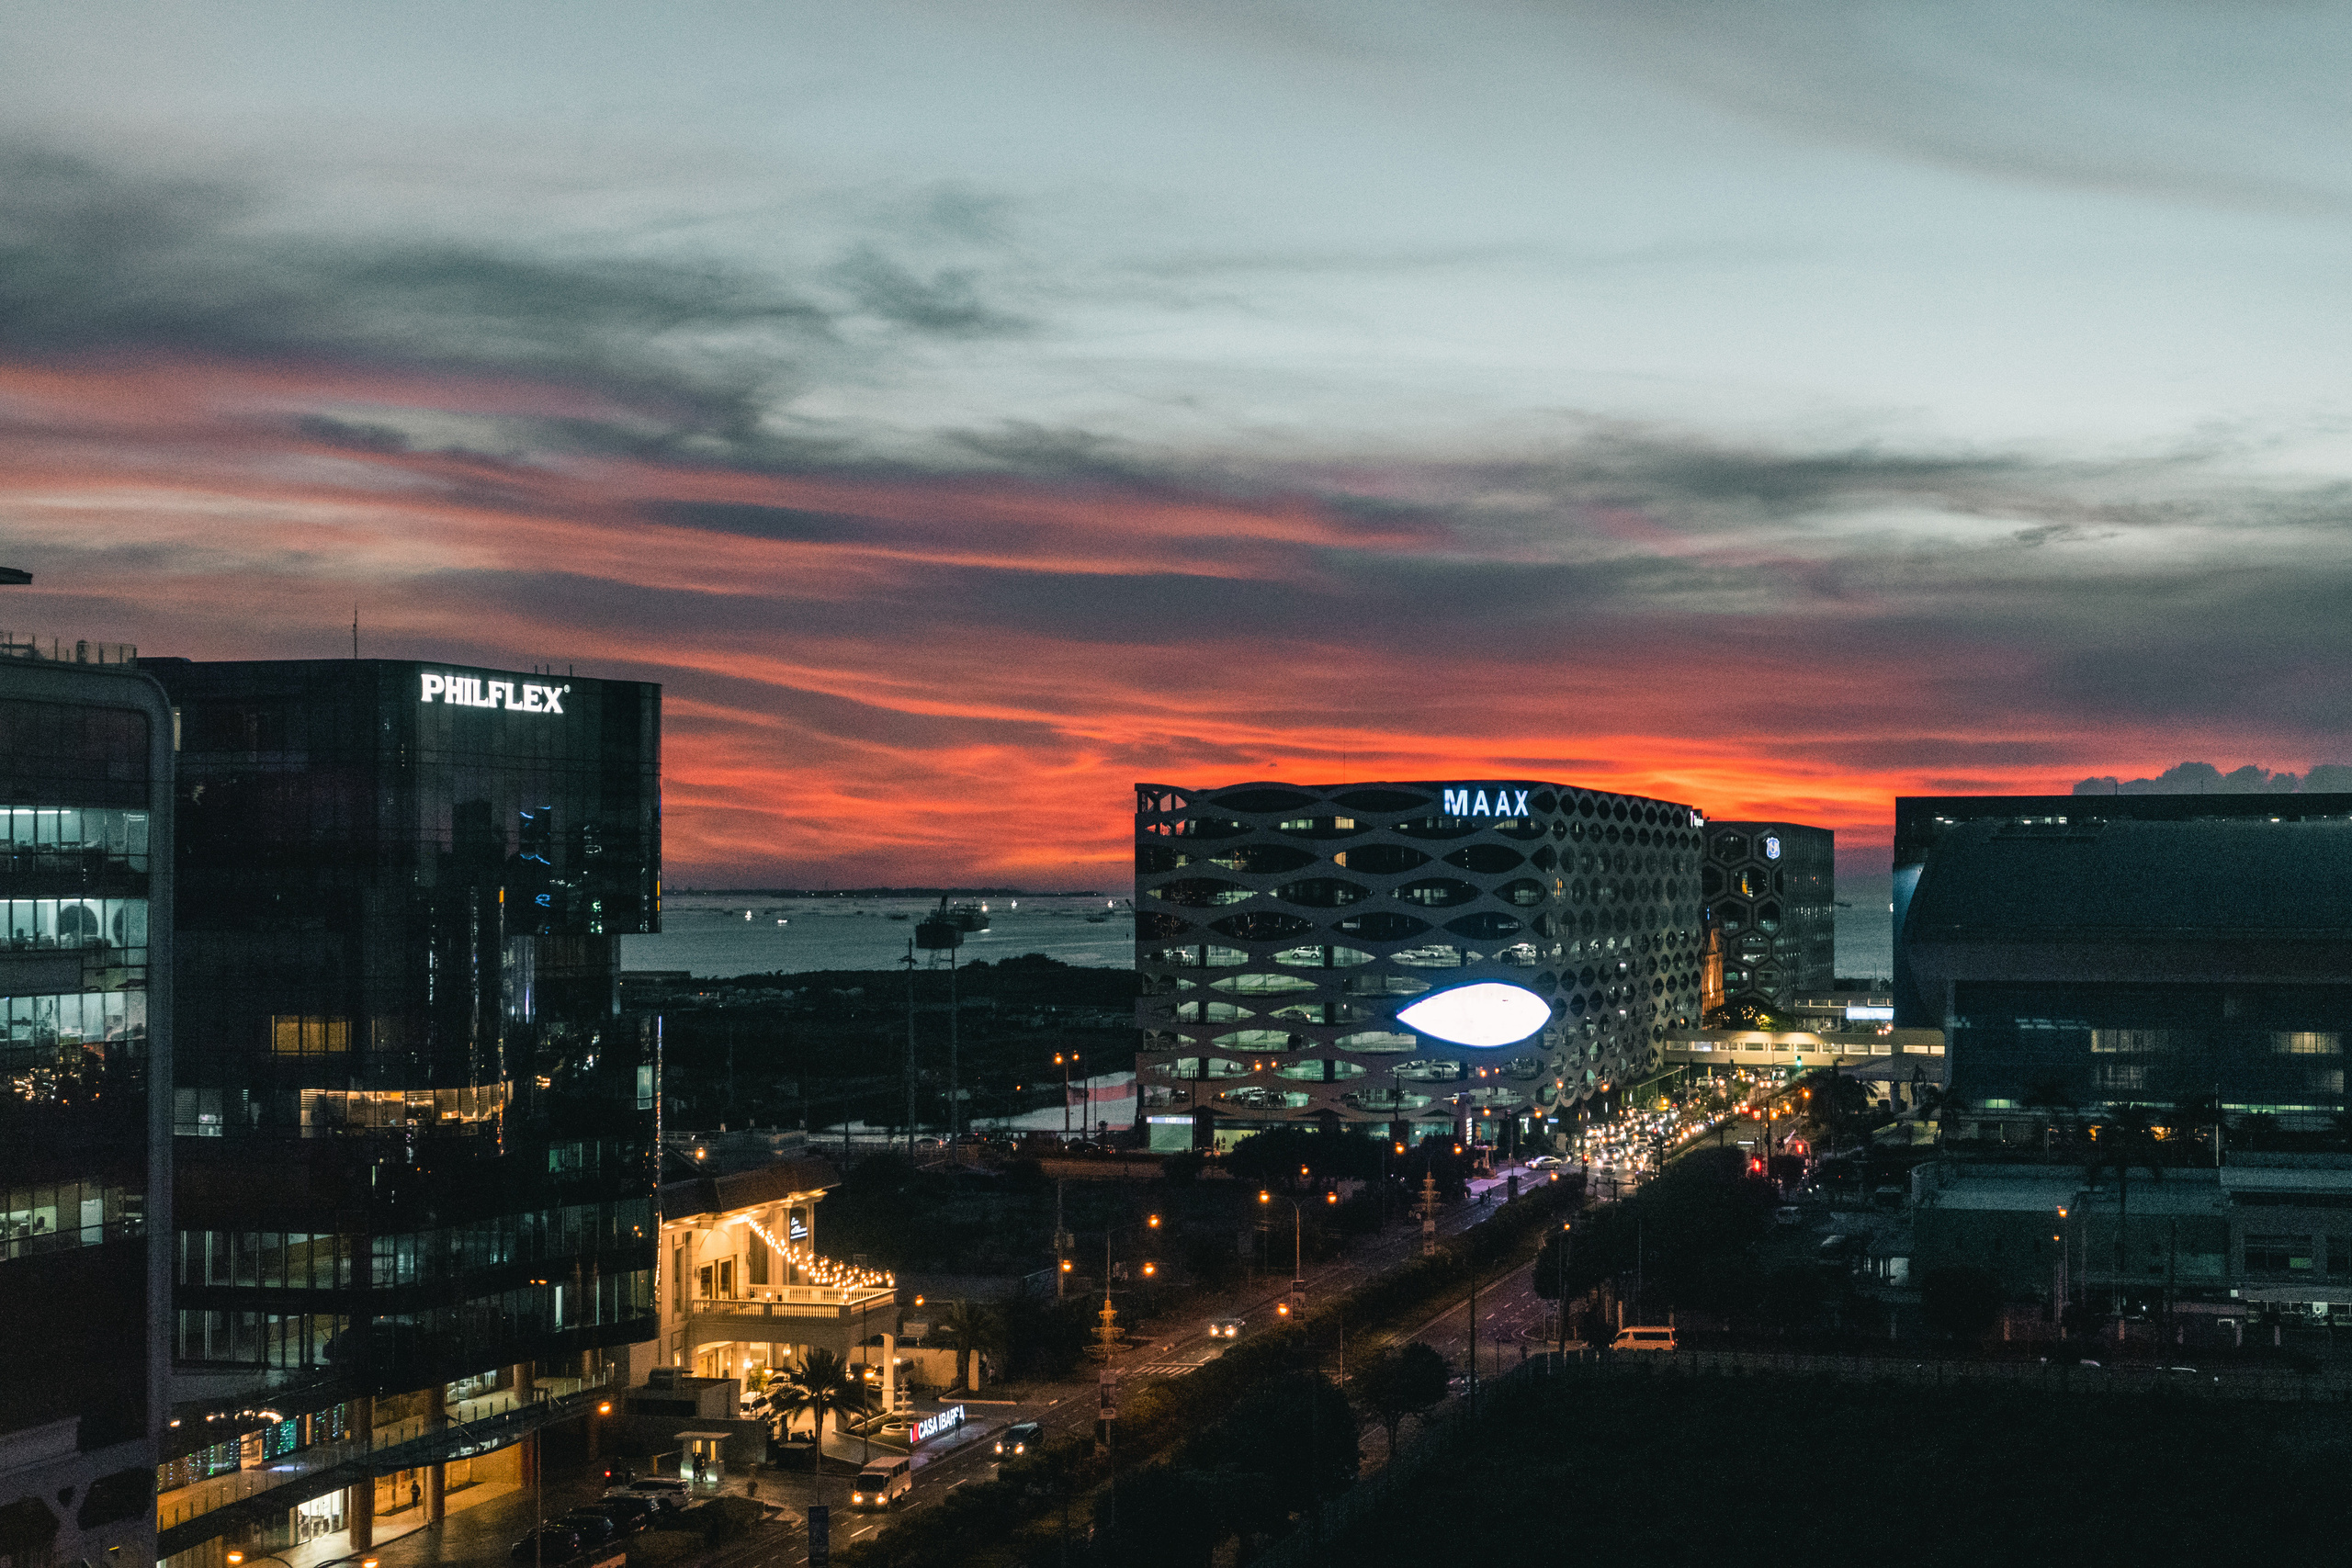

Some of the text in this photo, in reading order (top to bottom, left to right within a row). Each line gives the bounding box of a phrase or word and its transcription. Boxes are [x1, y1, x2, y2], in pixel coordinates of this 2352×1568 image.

[421, 673, 564, 714] PHILFLEX
[1444, 789, 1529, 817] MAAX
[918, 1416, 938, 1439] CASA
